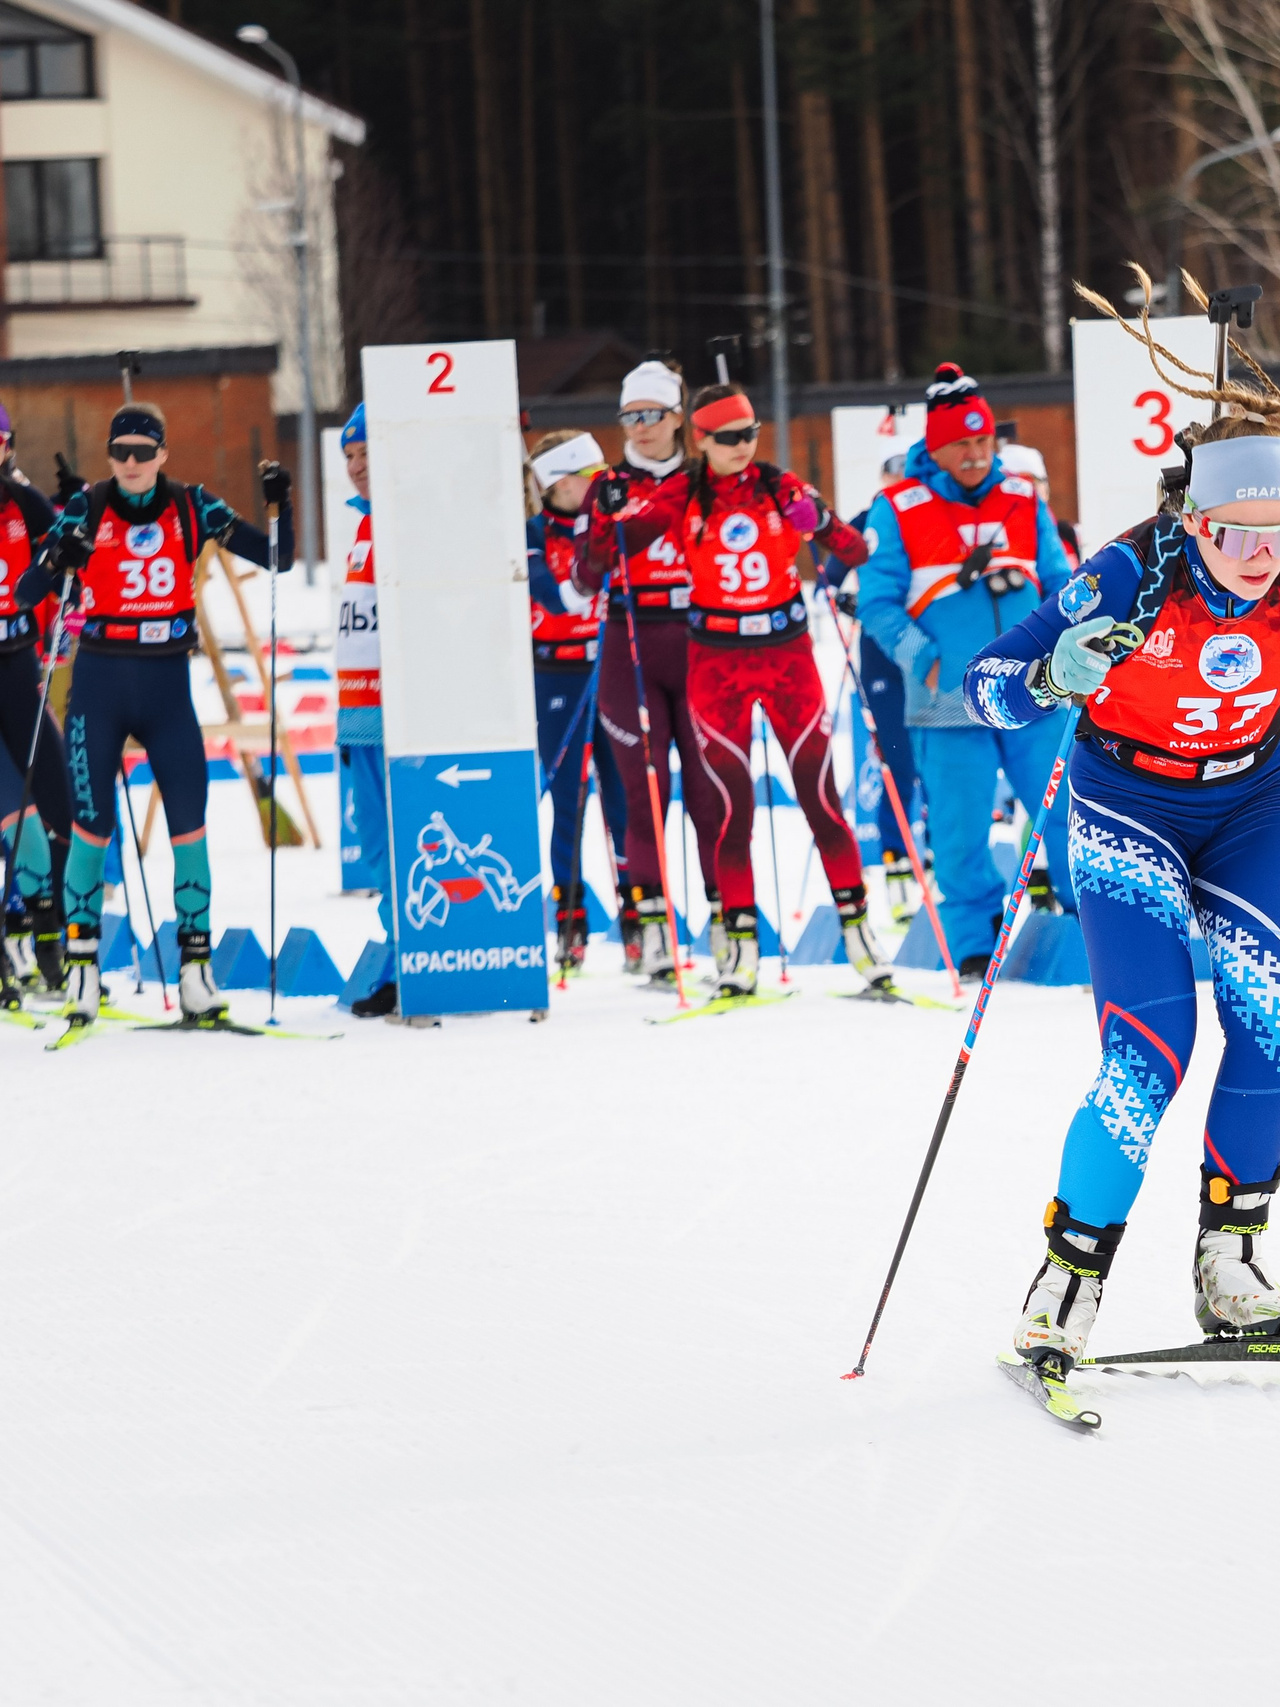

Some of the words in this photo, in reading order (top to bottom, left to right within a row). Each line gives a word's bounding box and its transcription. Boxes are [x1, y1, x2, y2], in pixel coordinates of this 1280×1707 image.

[427, 351, 455, 394] 2
[1133, 390, 1174, 456] 3
[118, 557, 175, 600] 38
[714, 551, 770, 593] 39
[974, 657, 1026, 677] ЯМАЛ
[1172, 688, 1277, 735] 37
[401, 945, 545, 975] КРАСНОЯРСК
